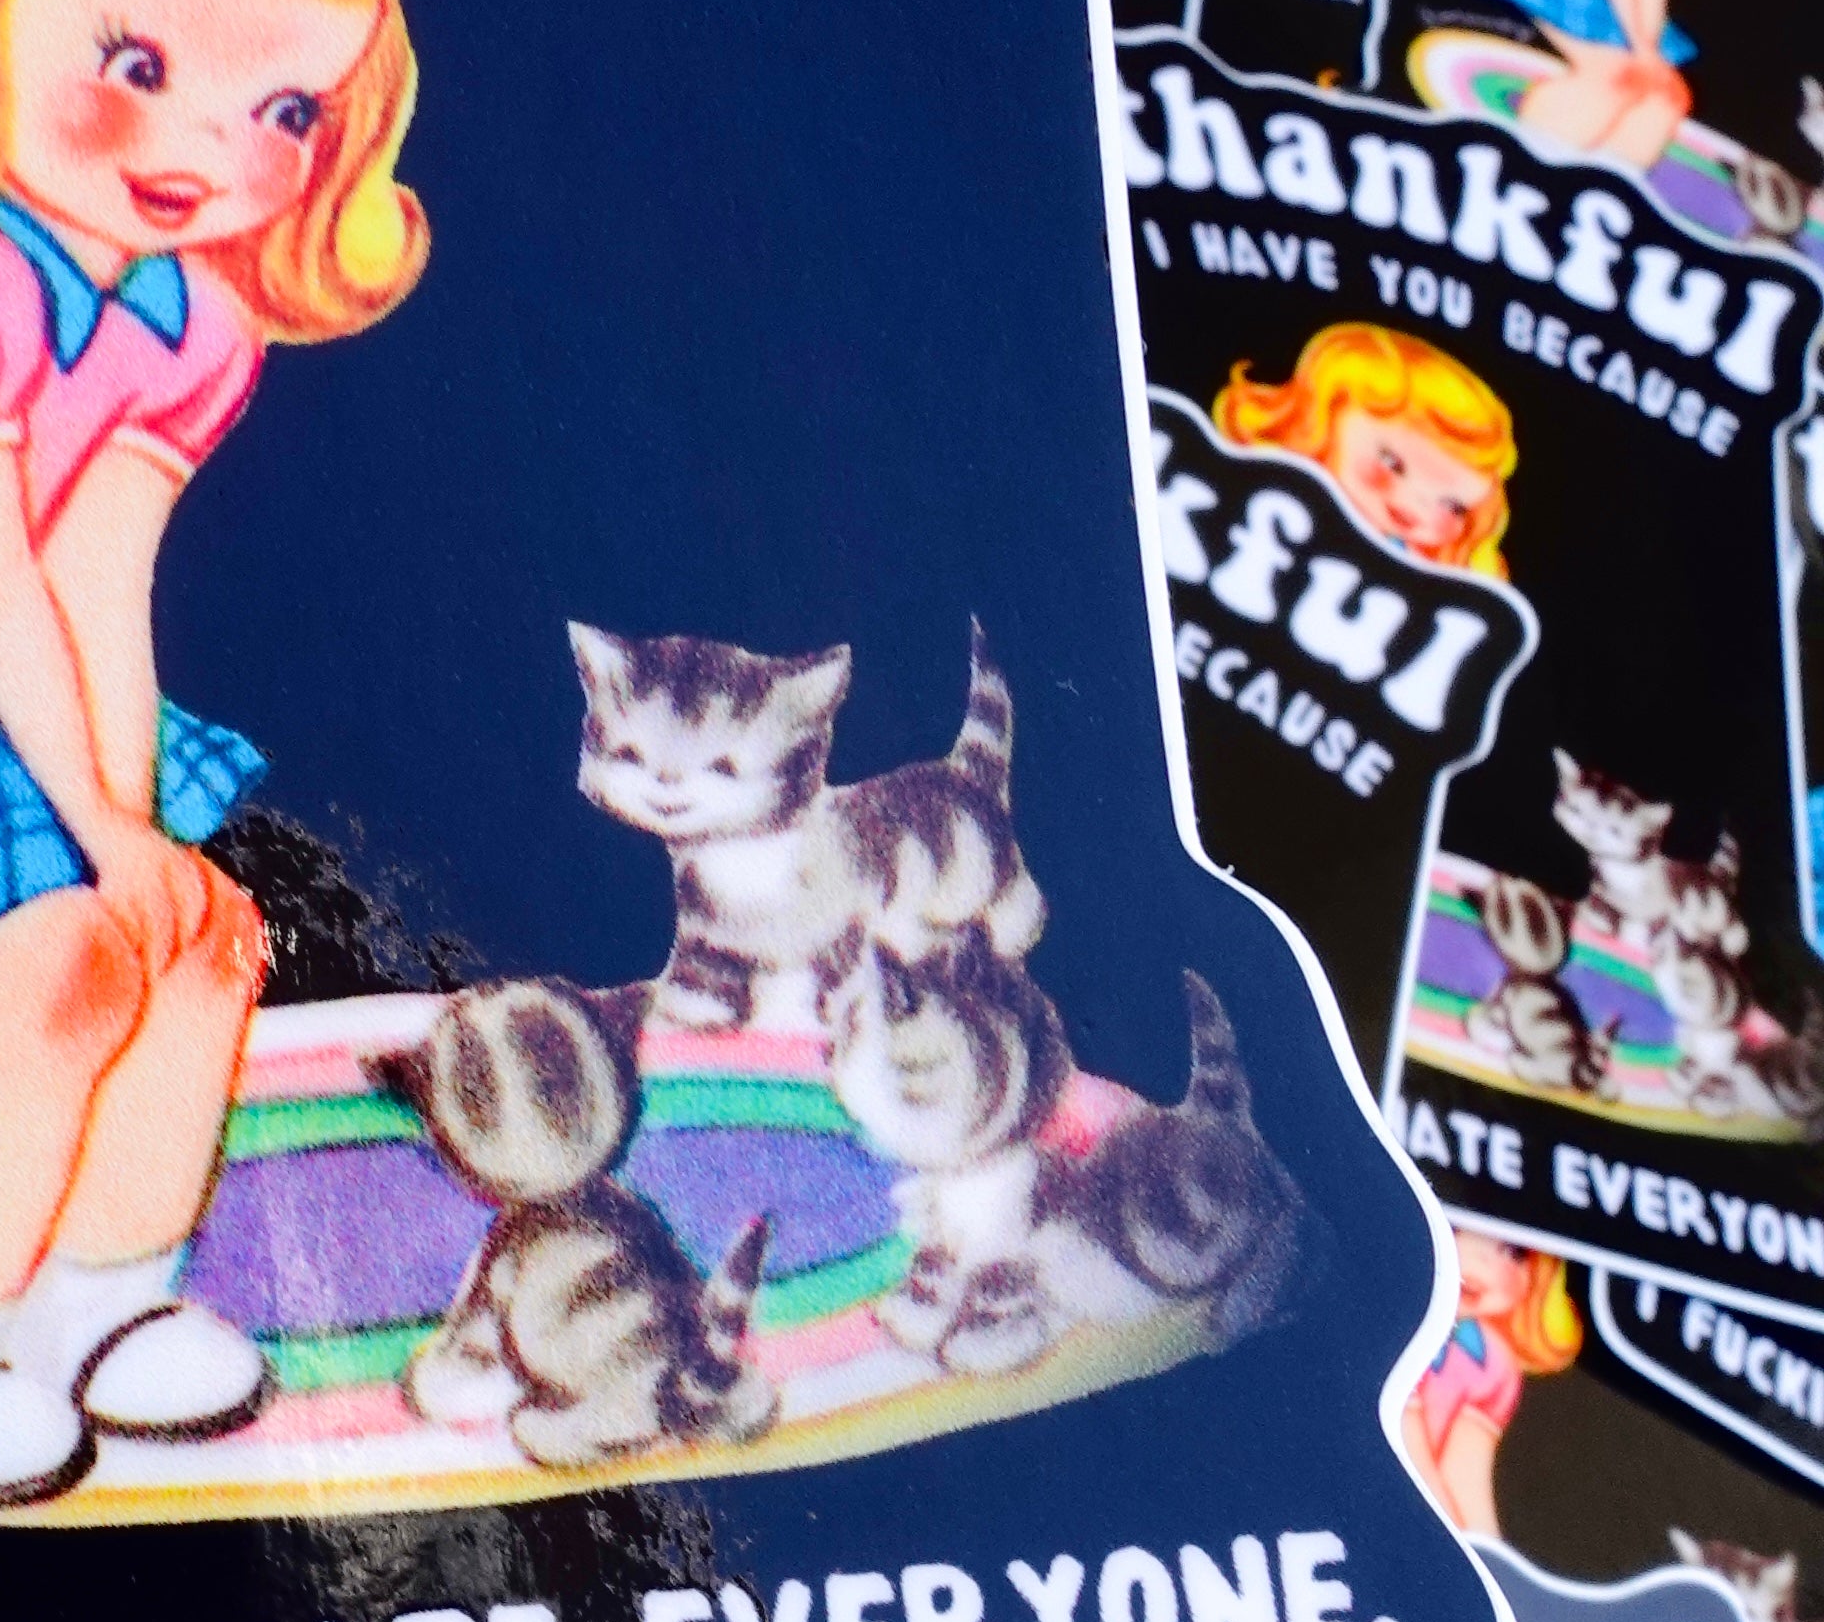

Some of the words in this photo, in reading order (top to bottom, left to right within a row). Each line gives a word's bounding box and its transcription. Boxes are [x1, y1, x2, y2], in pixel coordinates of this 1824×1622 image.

[1141, 218, 1172, 271] I
[1190, 220, 1339, 291] HAVE
[1369, 252, 1475, 329] YOU
[1503, 303, 1741, 458] BECAUSE
